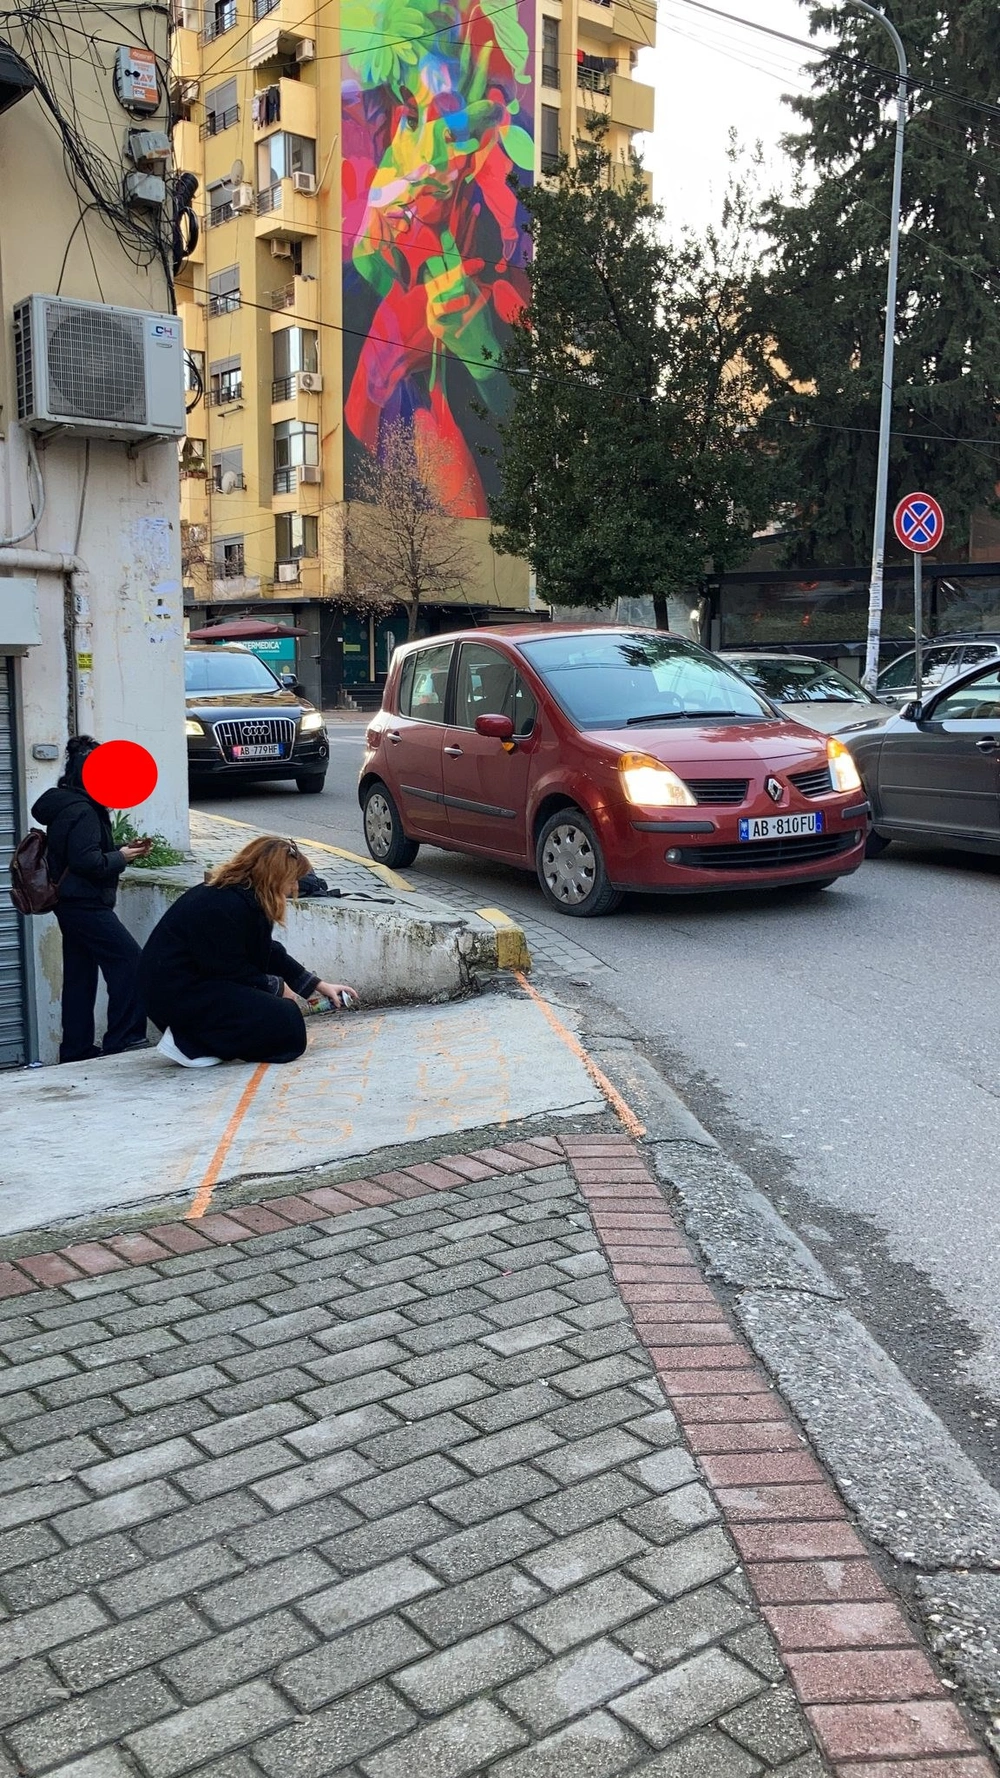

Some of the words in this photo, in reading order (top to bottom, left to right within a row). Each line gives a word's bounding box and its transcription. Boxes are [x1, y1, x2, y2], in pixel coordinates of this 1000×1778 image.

[155, 325, 173, 335] CH
[753, 820, 769, 837] AB
[776, 815, 815, 835] 810FU
